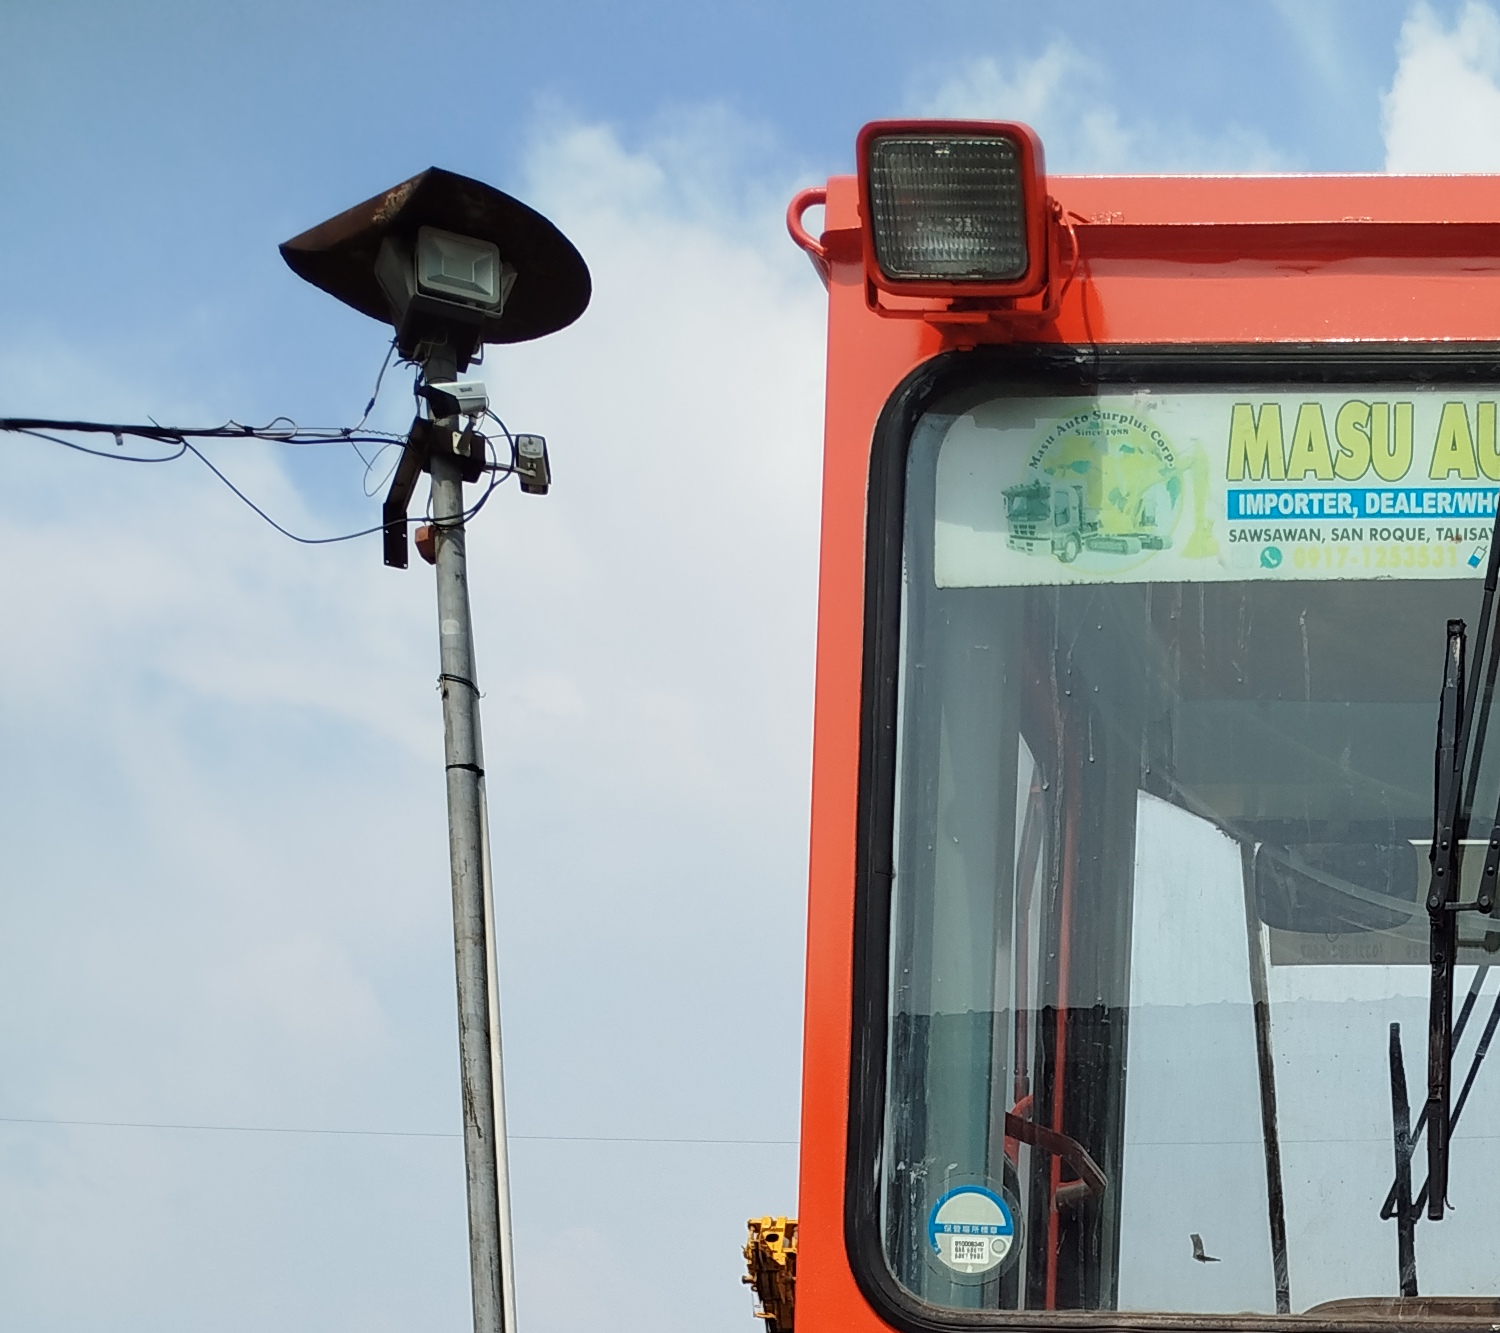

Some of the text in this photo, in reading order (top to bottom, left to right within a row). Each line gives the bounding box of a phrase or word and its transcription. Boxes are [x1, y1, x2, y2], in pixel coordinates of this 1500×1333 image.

[1029, 410, 1175, 469] Masu Auto Surplus Corp.
[1075, 428, 1129, 436] Since 1988
[1226, 399, 1413, 483] MASU
[1238, 493, 1359, 518] IMPORTER,
[1228, 528, 1326, 544] SAWSAWAN,
[1331, 527, 1363, 542] SAN
[1369, 527, 1431, 544] ROQUE,
